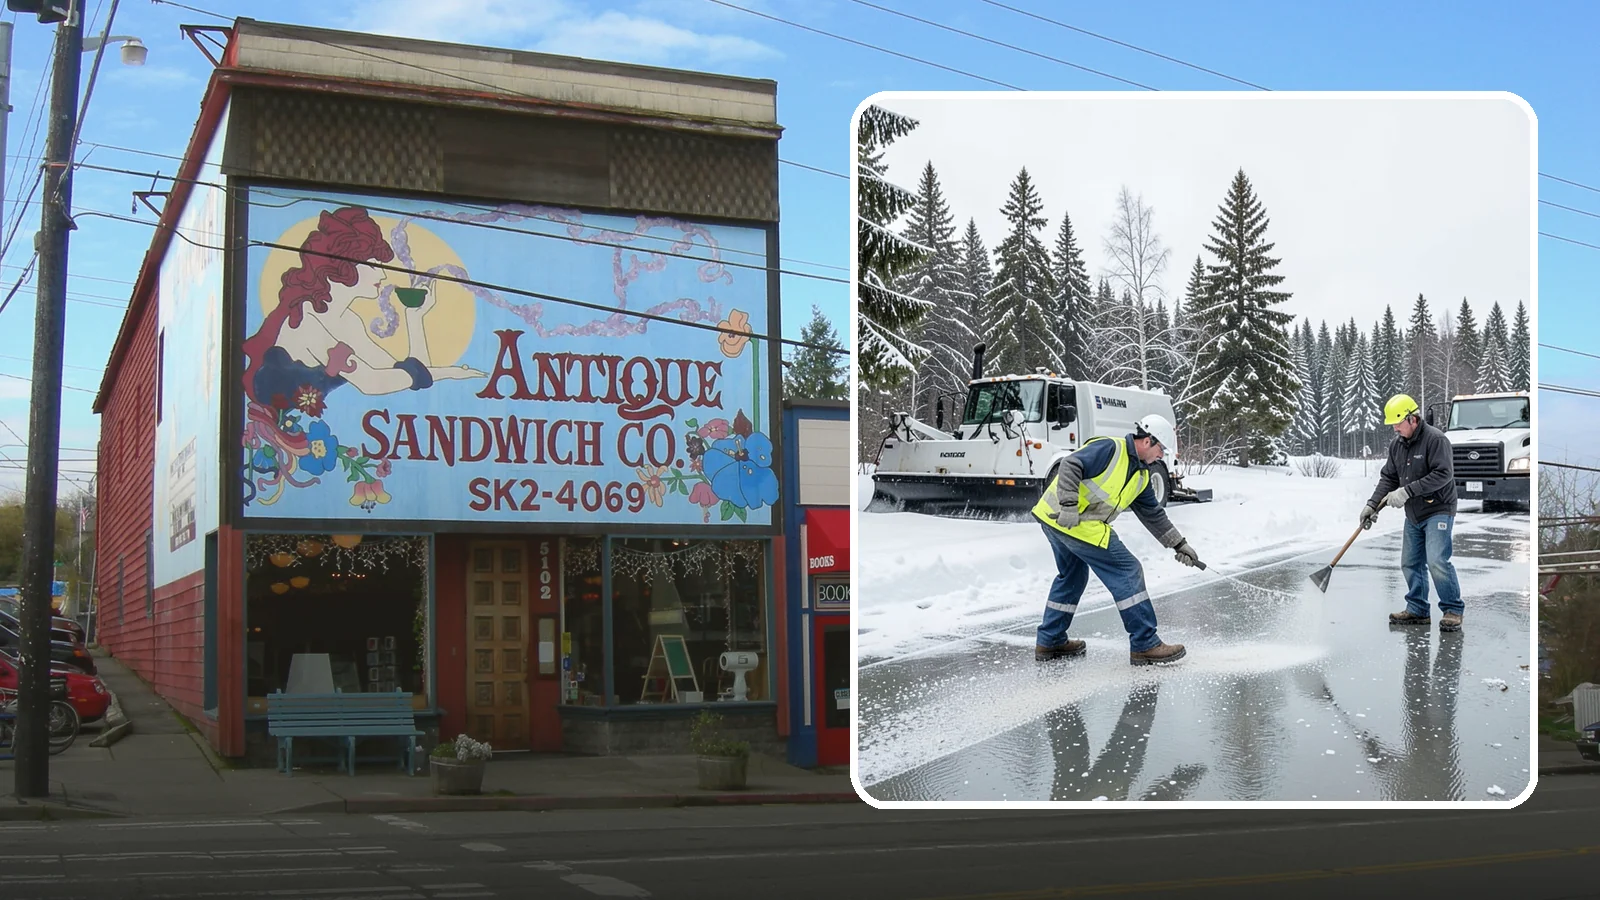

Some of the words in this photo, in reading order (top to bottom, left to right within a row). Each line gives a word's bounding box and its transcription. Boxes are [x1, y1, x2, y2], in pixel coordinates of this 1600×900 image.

[477, 329, 723, 419] ANTIQUE
[361, 409, 605, 466] SANDWICH
[617, 422, 686, 469] CO.
[469, 477, 646, 512] SK2-4069
[539, 542, 552, 600] 5102
[809, 555, 835, 569] BOOKS
